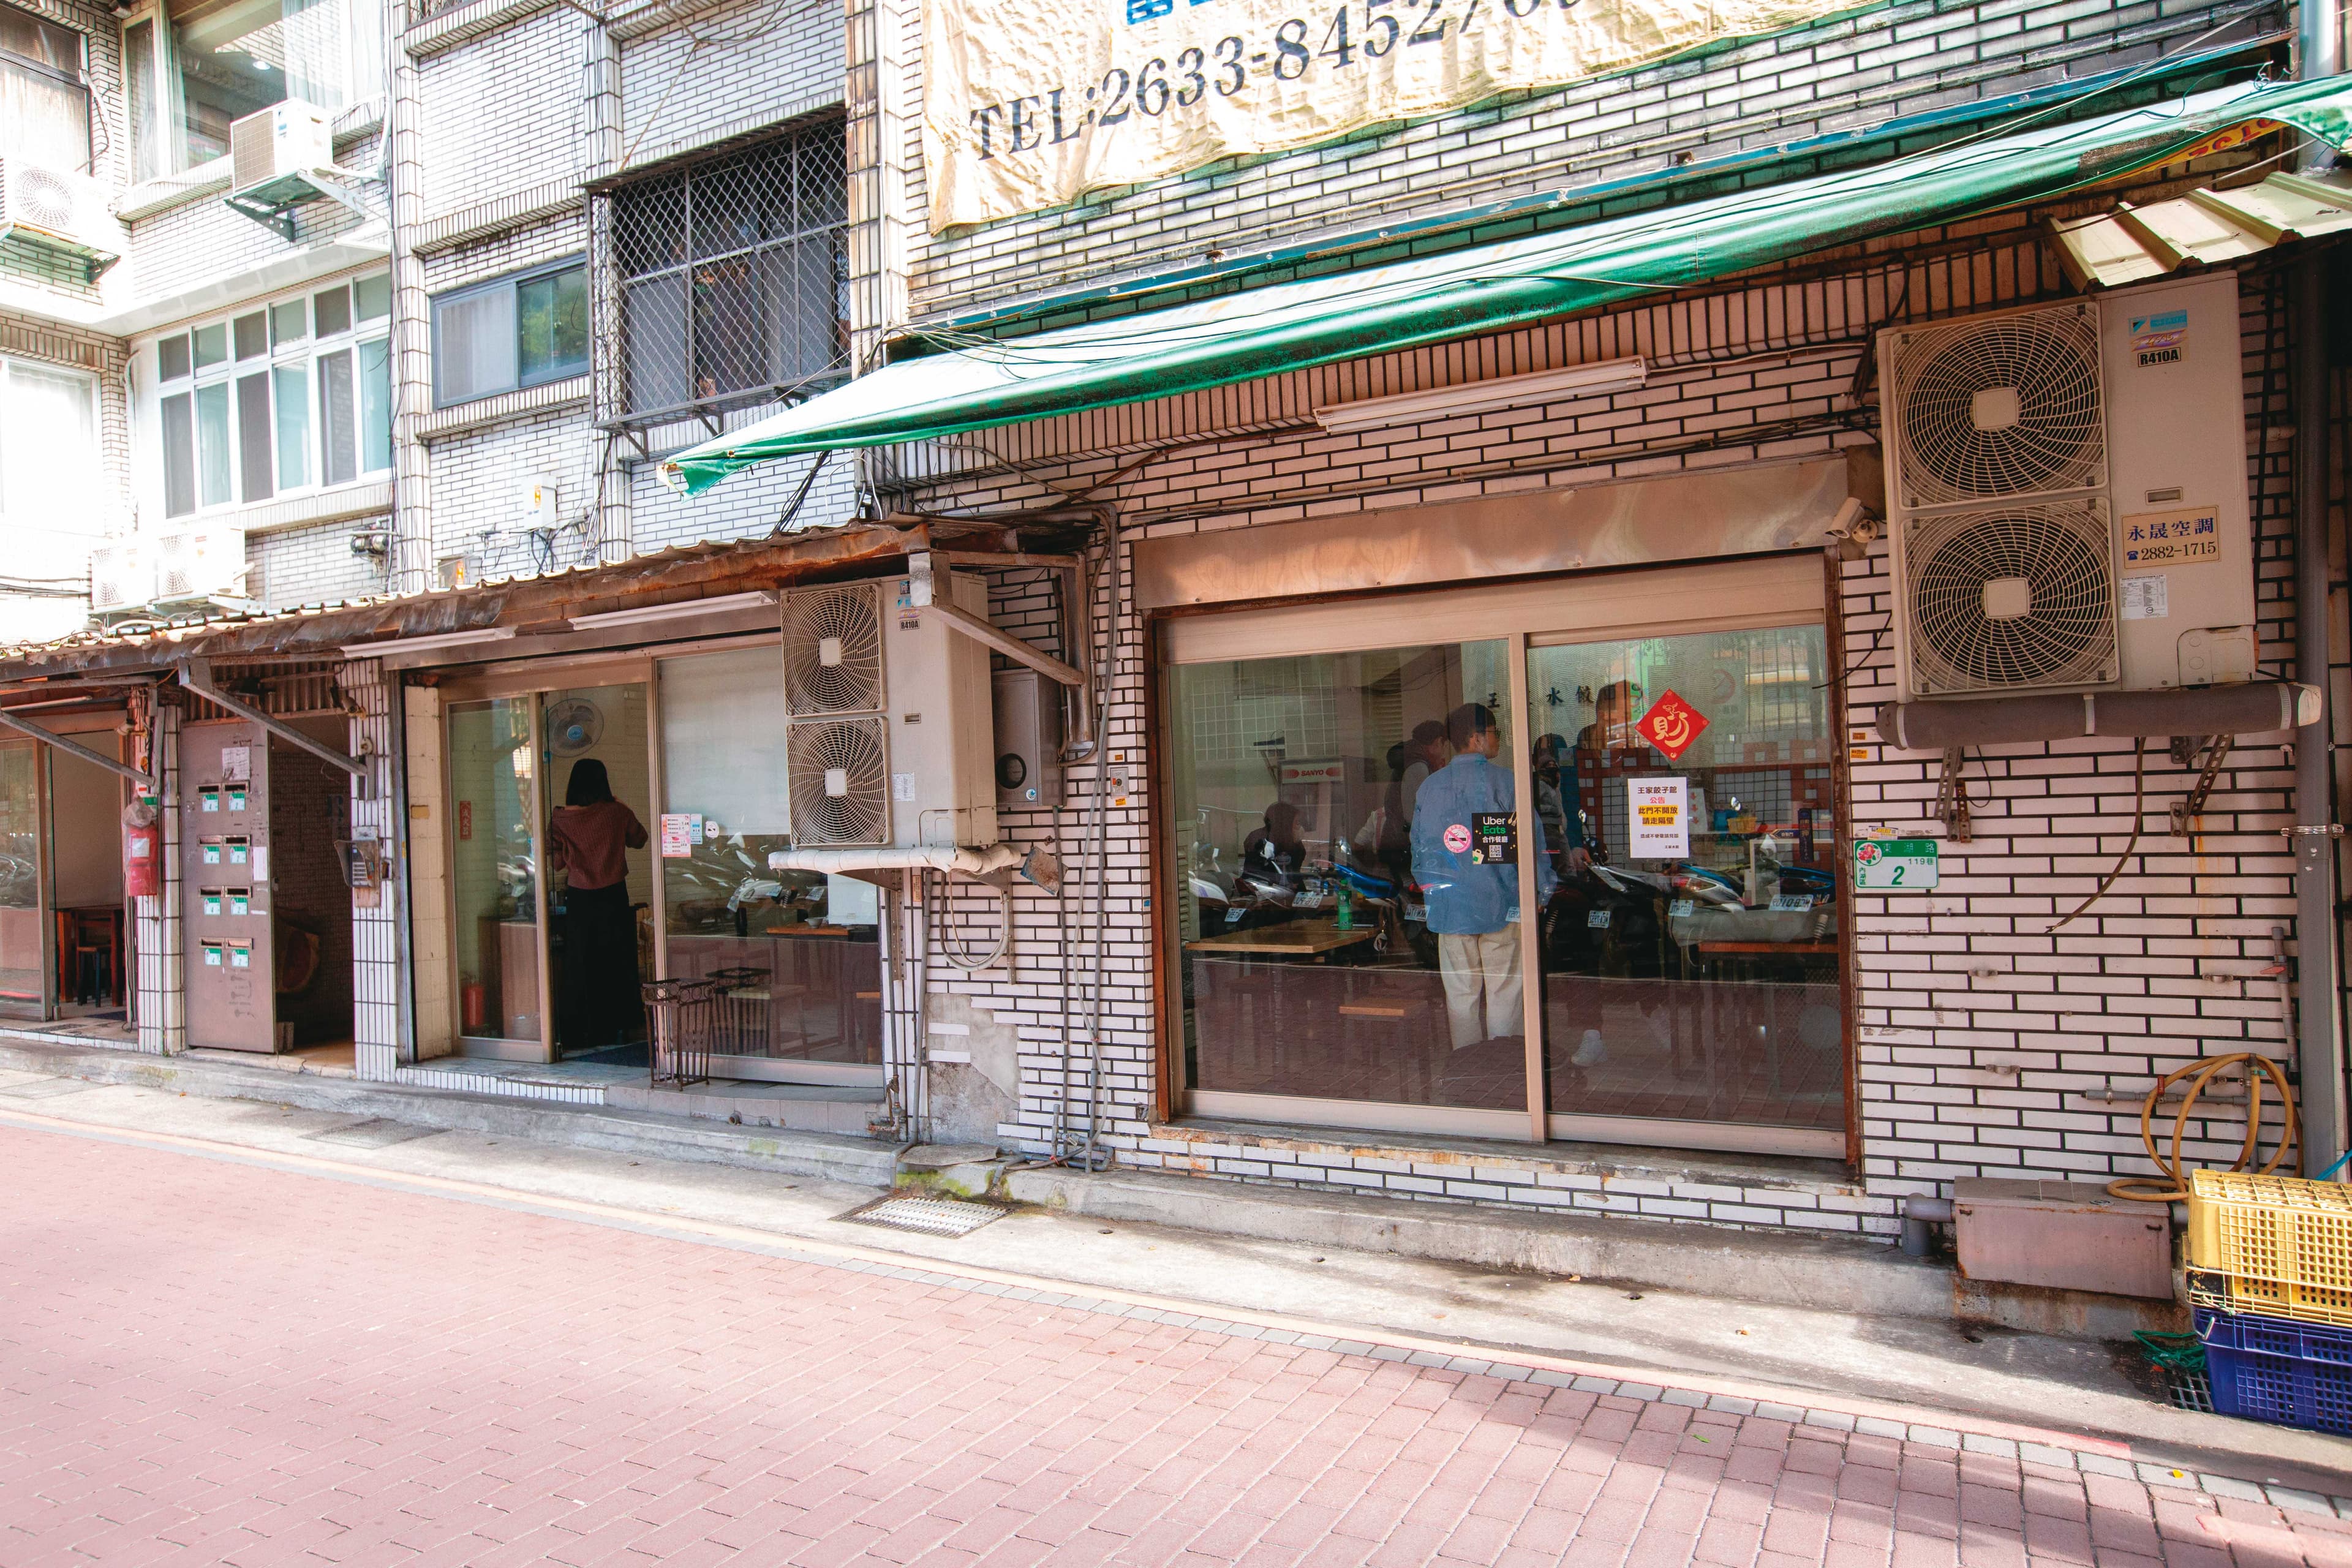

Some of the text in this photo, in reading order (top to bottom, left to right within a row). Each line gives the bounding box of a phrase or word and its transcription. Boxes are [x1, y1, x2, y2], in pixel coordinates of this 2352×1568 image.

[2139, 349, 2179, 366] R410A
[2127, 517, 2214, 541] 永晟空調
[2141, 541, 2217, 561] 2882-1715
[900, 620, 919, 630] R410A
[1637, 786, 1678, 794] 王家餃子館
[1482, 816, 1506, 825] Uber
[1483, 826, 1506, 834] Eats
[1882, 843, 1934, 853] 東湖路
[1891, 865, 1904, 884] 2
